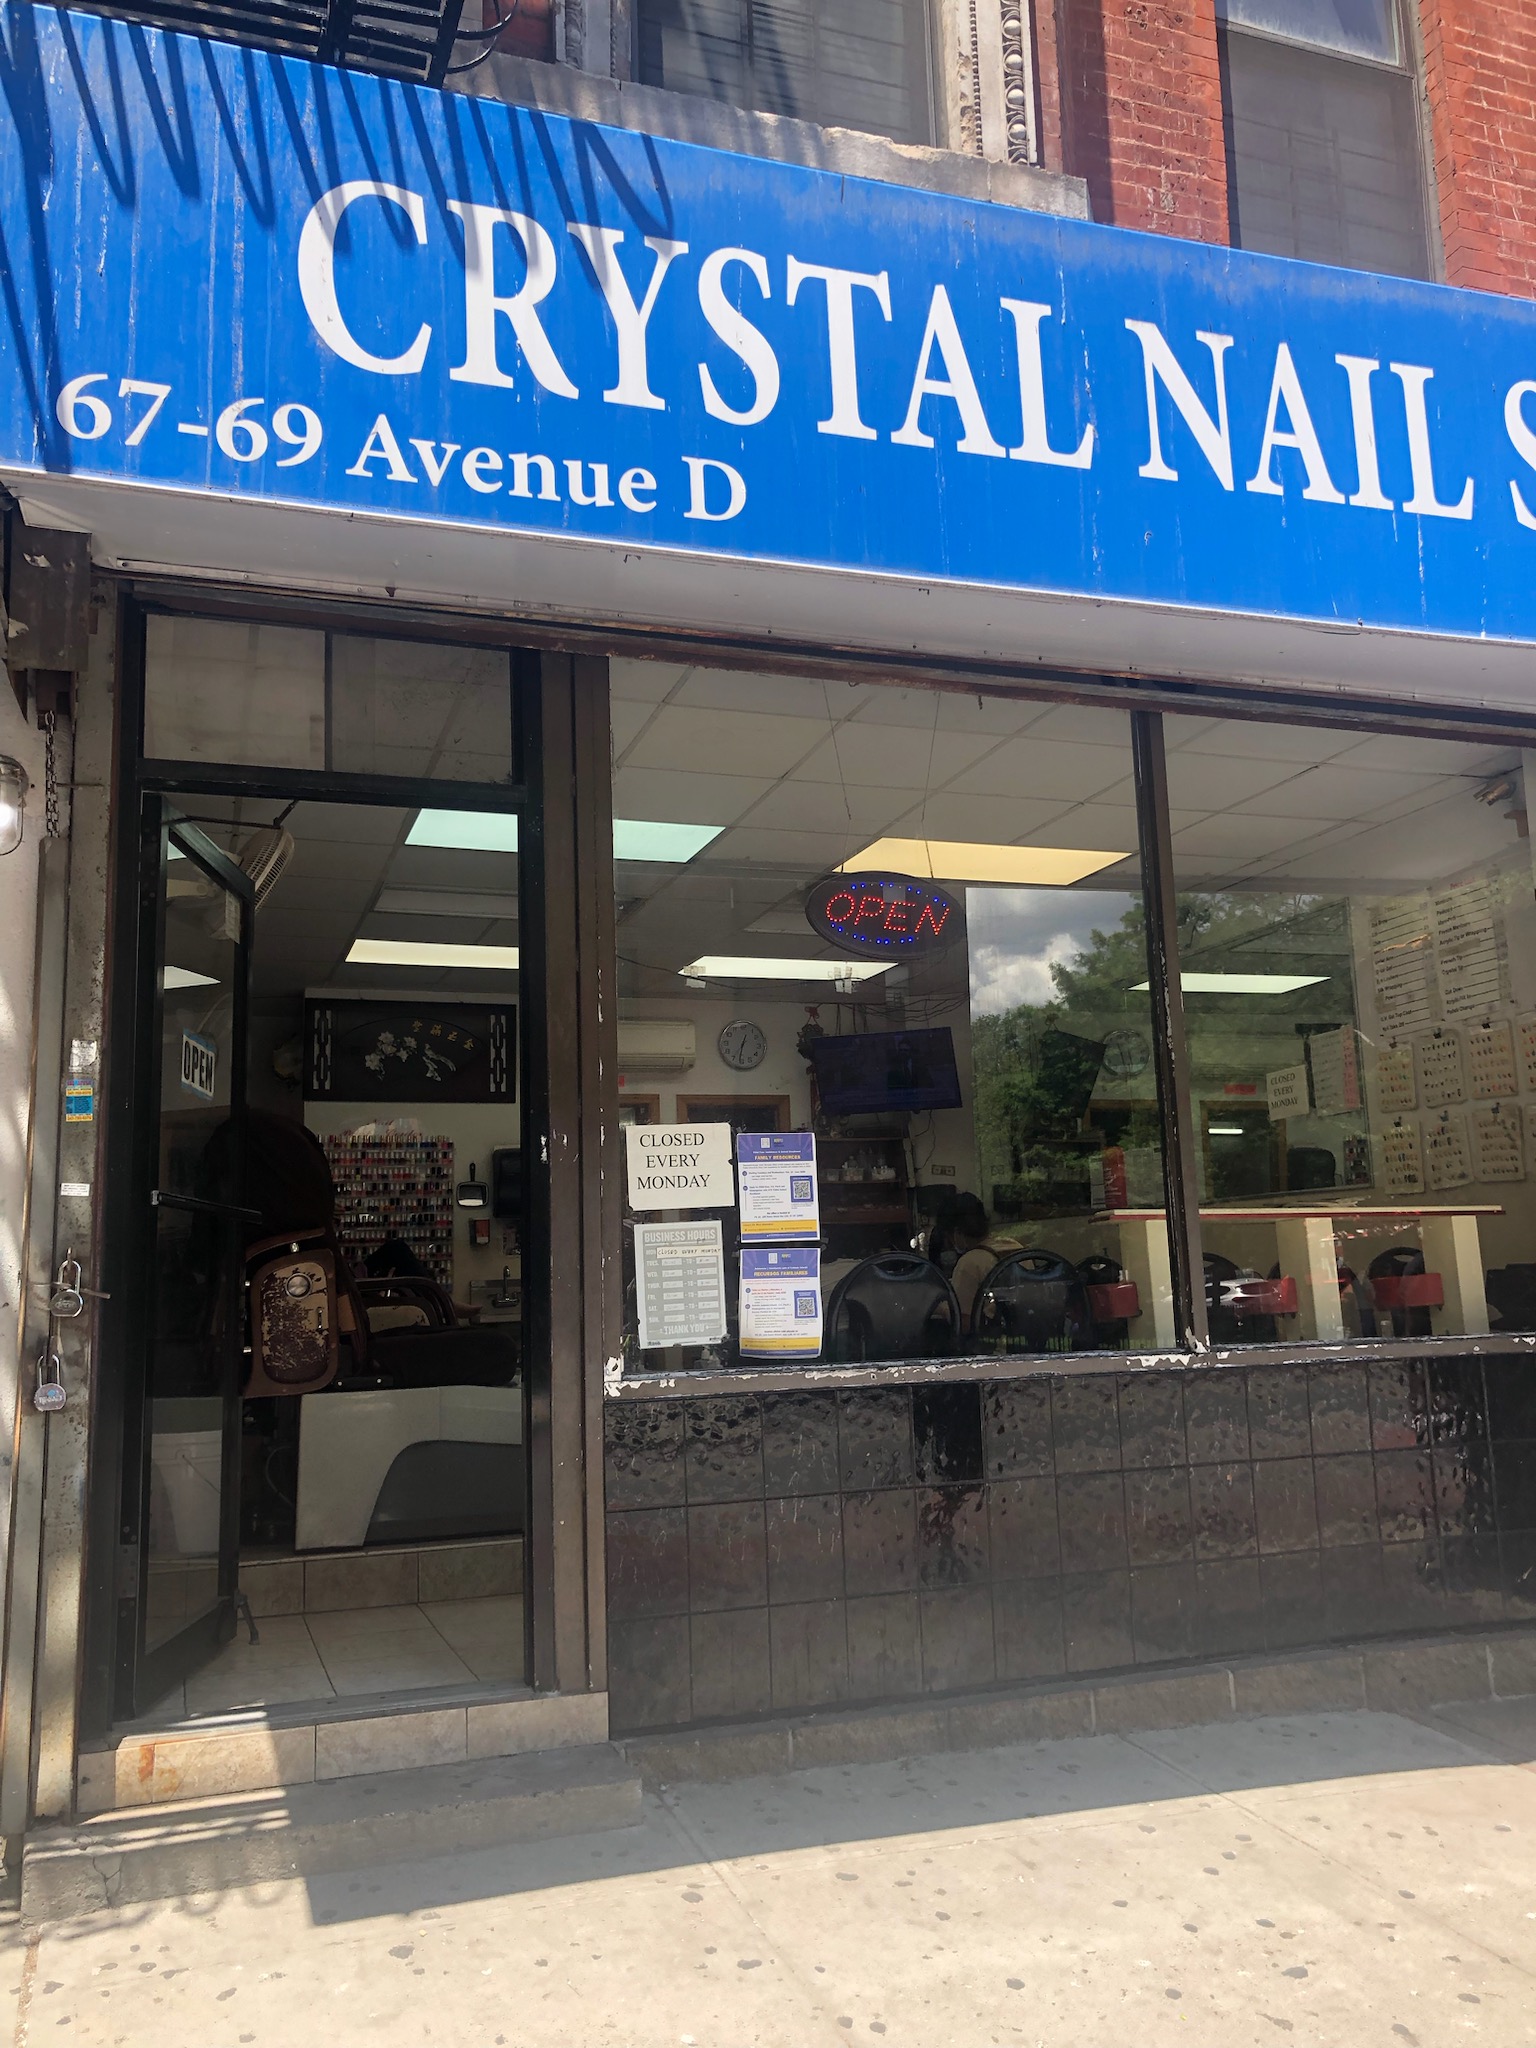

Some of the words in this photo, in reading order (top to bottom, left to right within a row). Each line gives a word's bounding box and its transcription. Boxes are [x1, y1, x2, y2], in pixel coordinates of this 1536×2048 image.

[298, 179, 1094, 471] CRYSTAL
[1124, 318, 1474, 521] NAIL
[56, 373, 323, 468] 67-69
[345, 413, 657, 513] Avenue
[680, 455, 747, 522] D
[825, 892, 951, 936] OPEN
[183, 1040, 214, 1093] OPEN
[1270, 1072, 1296, 1086] CLOSED
[1273, 1085, 1294, 1097] EVERY
[1270, 1097, 1298, 1109] MONDAY
[639, 1132, 705, 1148] CLOSED
[645, 1153, 701, 1169] EVERY
[636, 1174, 711, 1190] MONDAY
[644, 1231, 686, 1243] BUSINESS
[687, 1229, 716, 1241] HOURS
[663, 1325, 689, 1335] THANK
[689, 1323, 705, 1333] YOU
